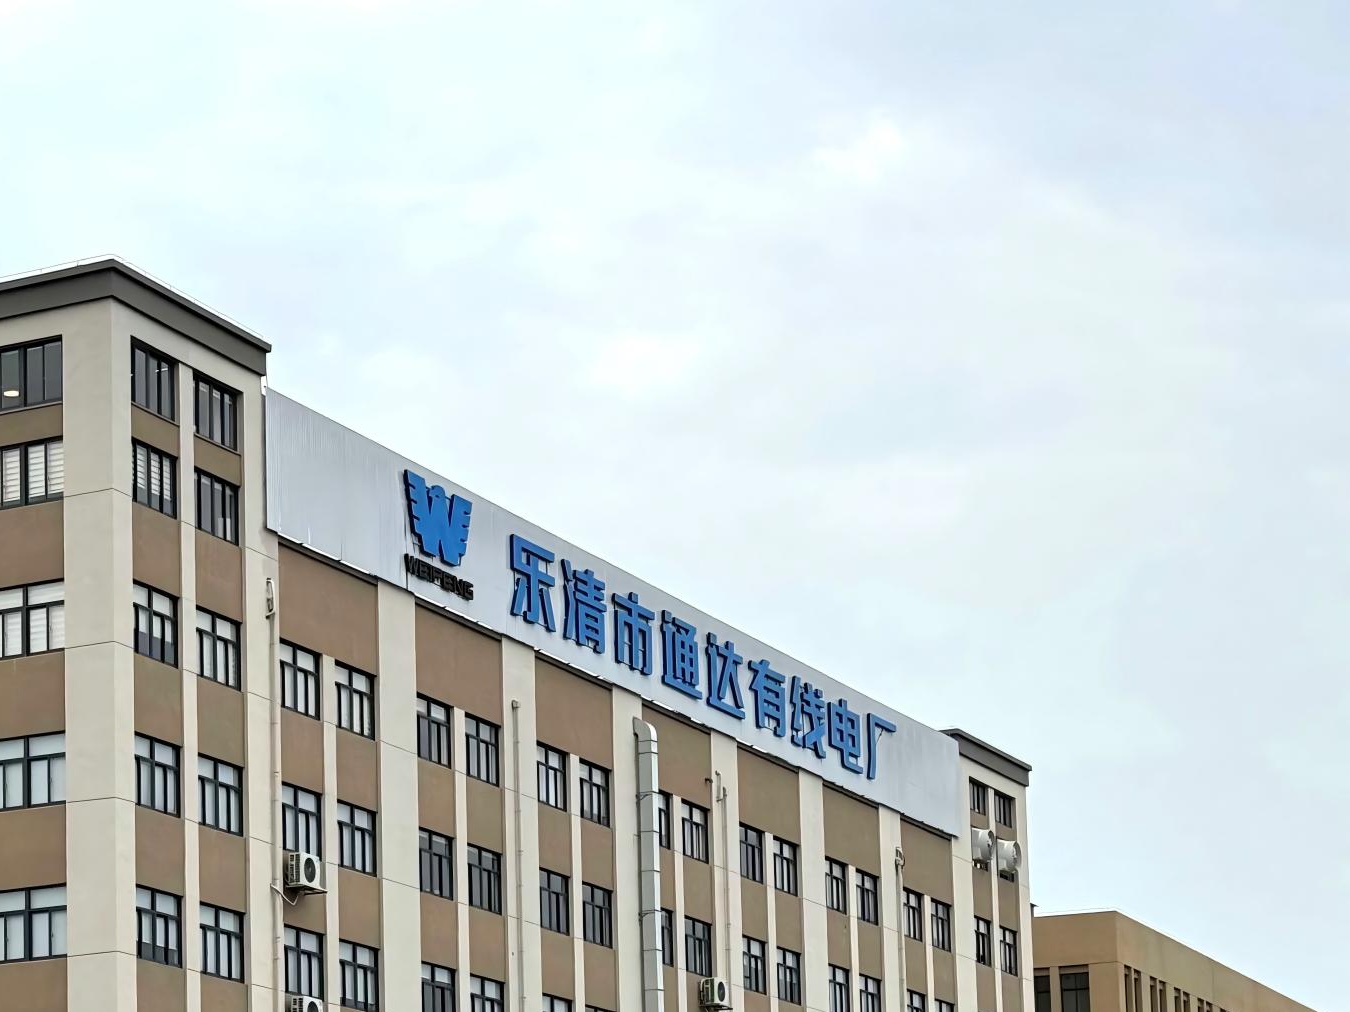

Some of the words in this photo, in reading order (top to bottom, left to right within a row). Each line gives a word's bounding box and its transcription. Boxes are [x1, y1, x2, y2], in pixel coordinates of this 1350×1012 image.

[404, 553, 474, 600] WEIFENG
[510, 534, 896, 780] 乐清市通达有线电厂
